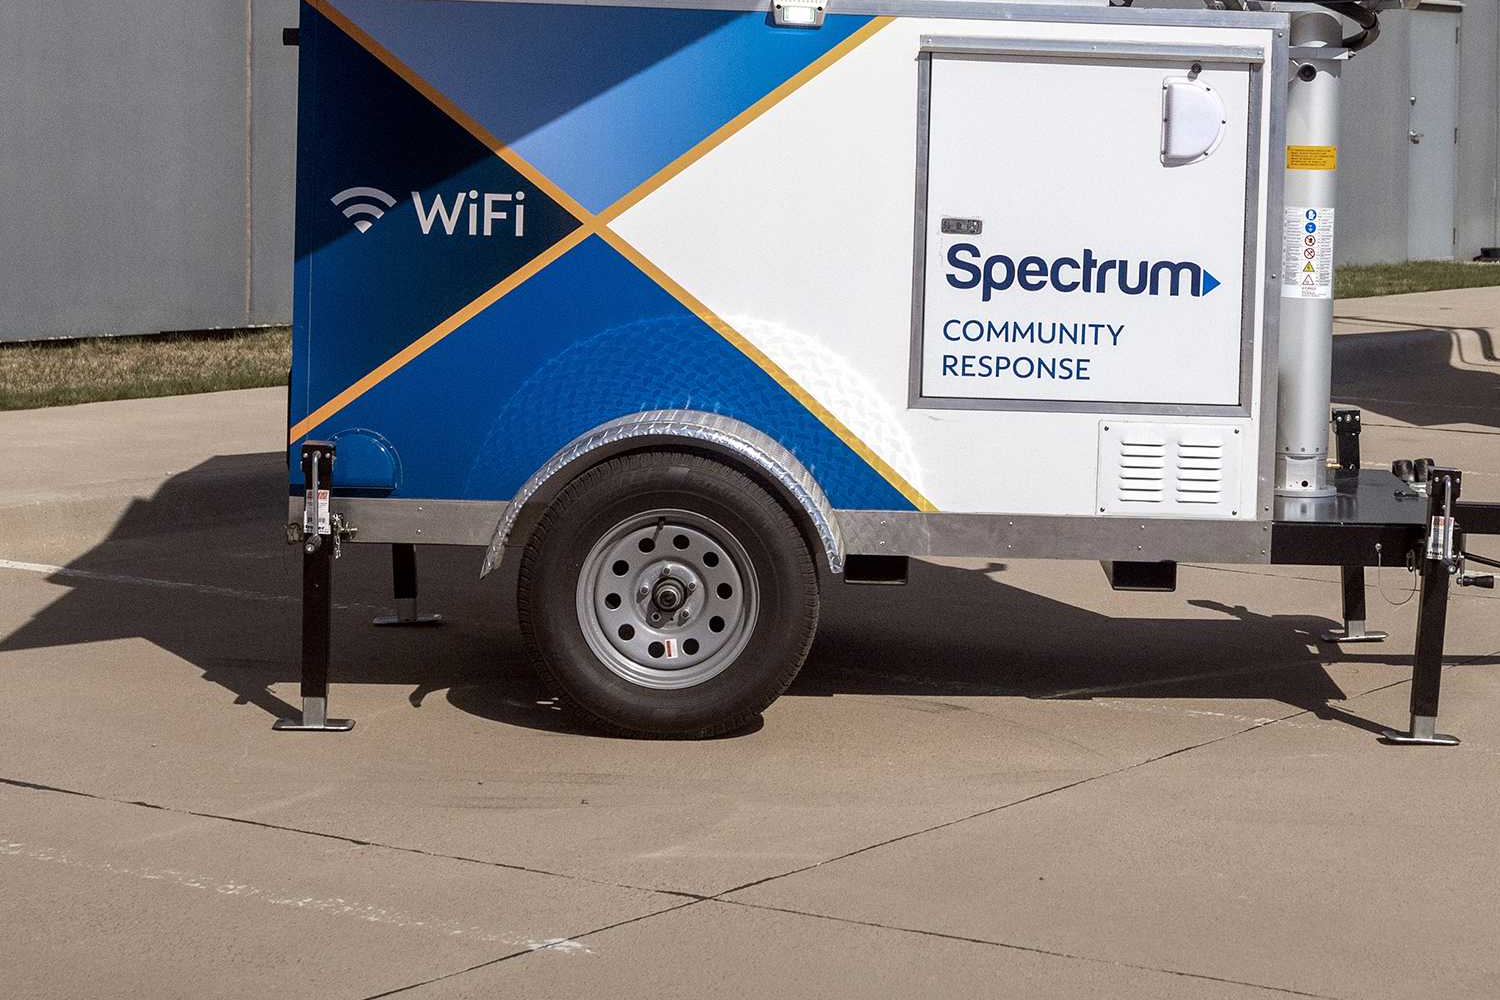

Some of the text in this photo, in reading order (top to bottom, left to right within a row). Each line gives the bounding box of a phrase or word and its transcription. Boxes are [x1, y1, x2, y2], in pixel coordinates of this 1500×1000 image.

[411, 189, 527, 238] WiFi
[945, 242, 1201, 302] Spectrum
[943, 319, 1125, 346] COMMUNITY
[942, 354, 1091, 381] RESPONSE
